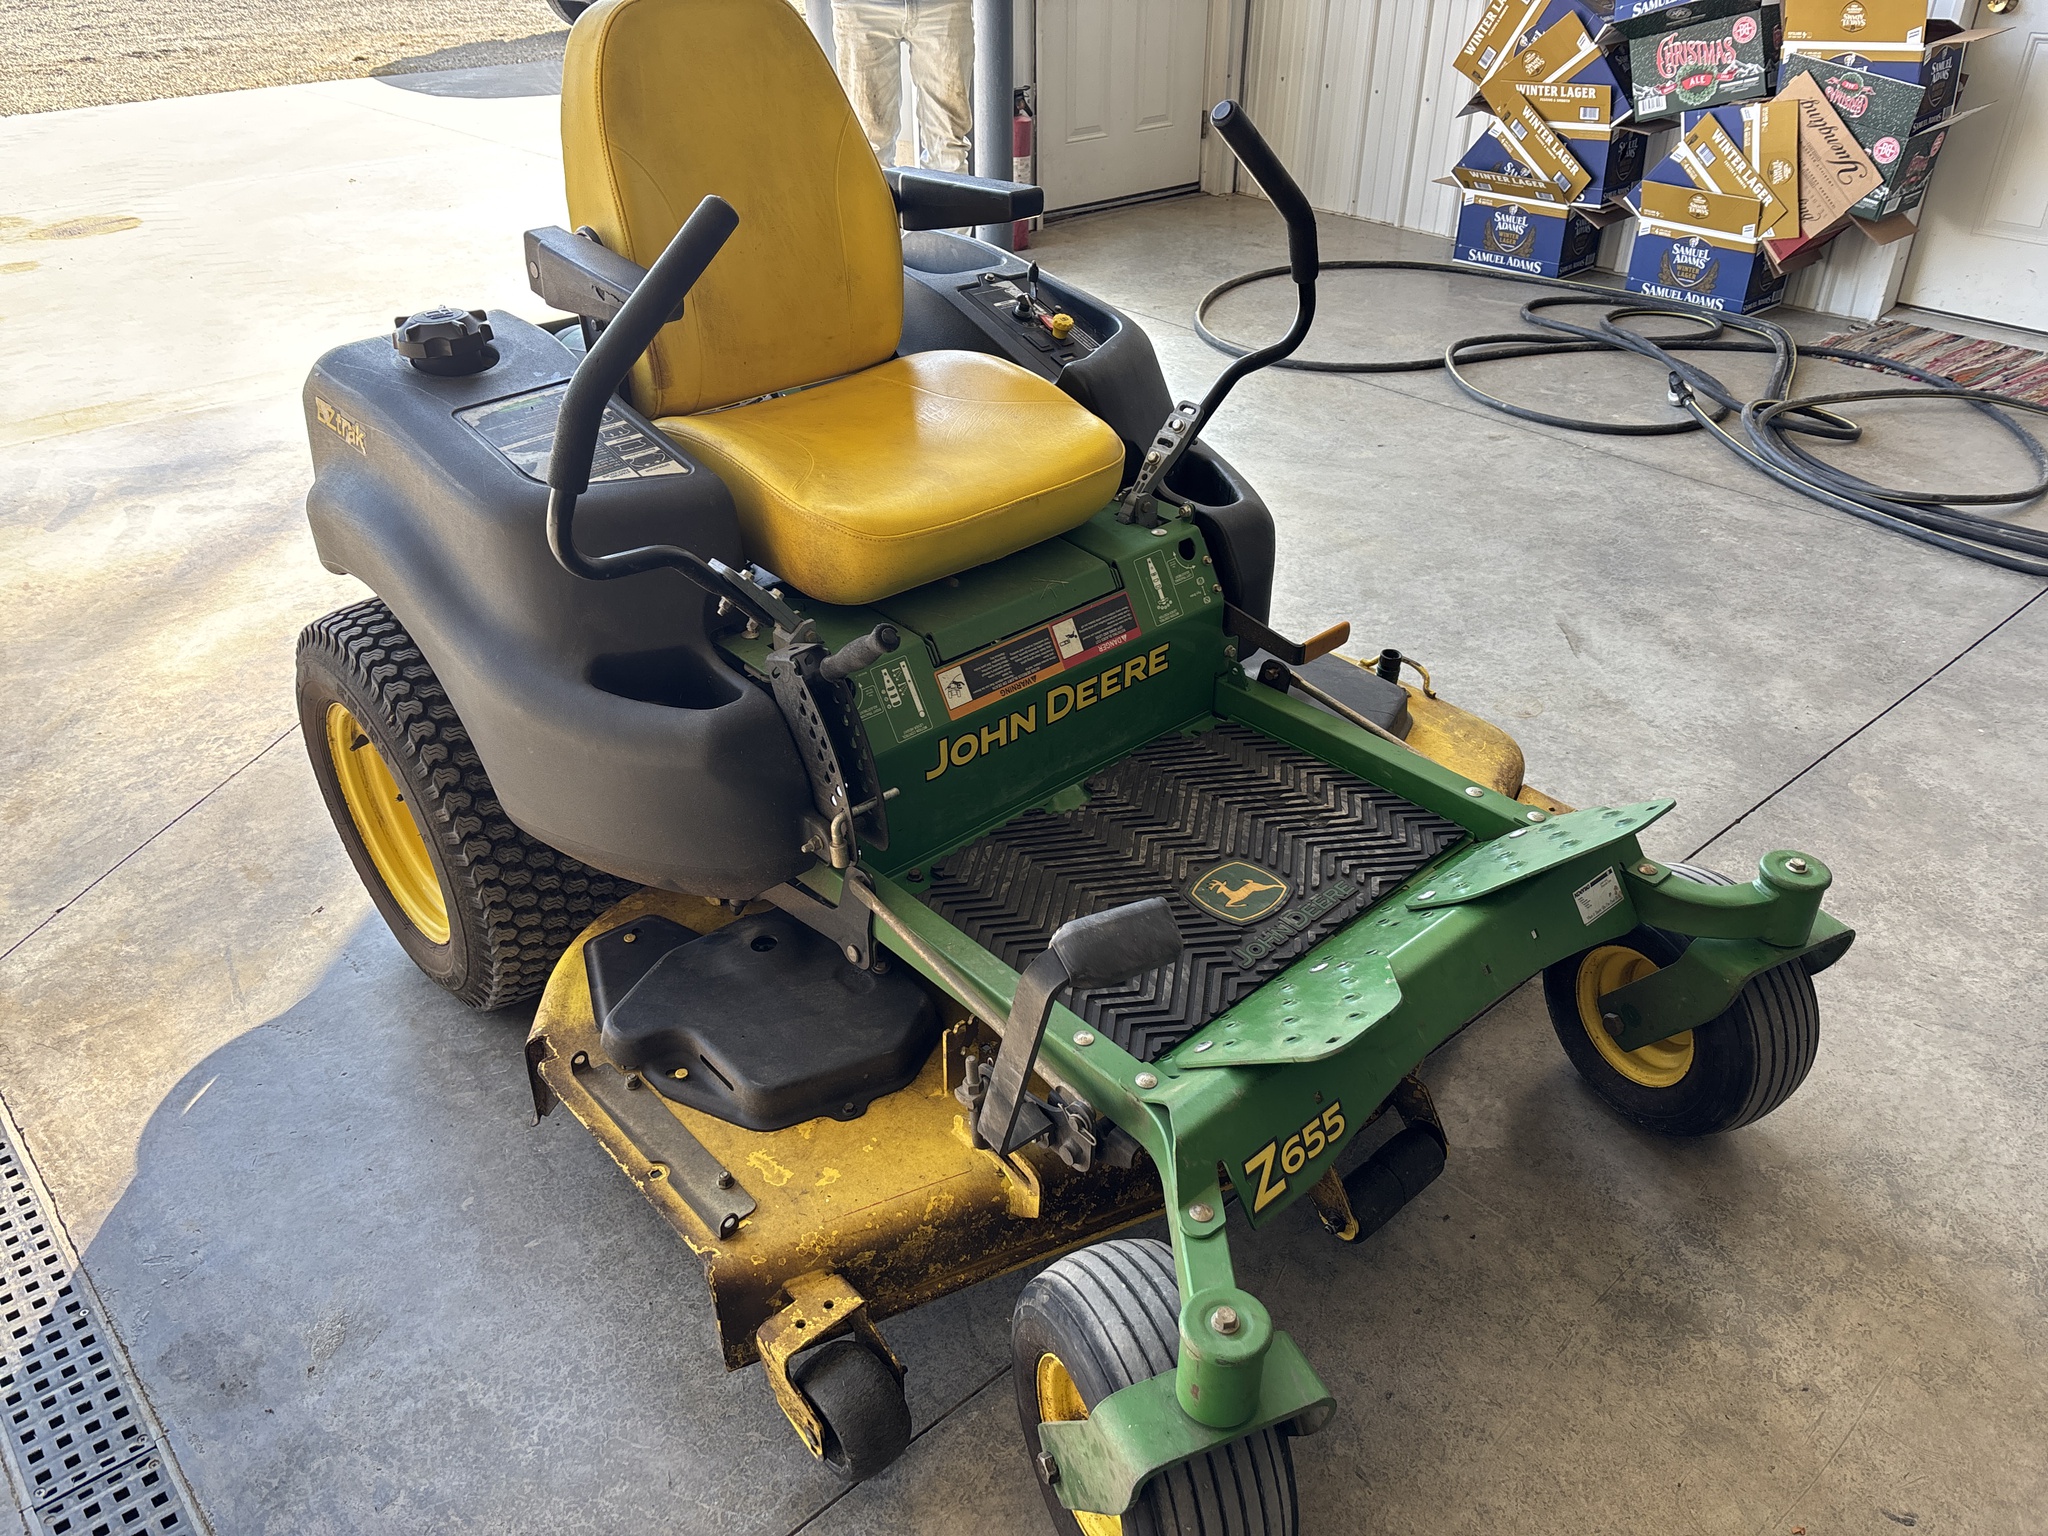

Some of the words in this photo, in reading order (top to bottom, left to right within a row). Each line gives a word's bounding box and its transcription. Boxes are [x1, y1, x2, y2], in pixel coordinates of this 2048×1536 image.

[1463, 11, 1497, 56] WINTER
[1656, 32, 1736, 78] CHRISTMAS
[1688, 75, 1705, 86] ALE
[1515, 84, 1558, 97] WINTER
[1560, 86, 1596, 99] LAGER
[1522, 105, 1555, 146] WINTER
[1552, 145, 1579, 176] LAGER
[1711, 128, 1747, 173] WINTER
[1742, 170, 1774, 207] LAGER
[1469, 170, 1511, 183] WINTER
[1511, 177, 1546, 189] LAGER
[1494, 211, 1528, 227] SAMUEL
[1495, 222, 1524, 235] ADAMS
[1468, 248, 1506, 265] SAMUEL
[1506, 256, 1542, 274] ADAMS
[1672, 243, 1711, 261] SAMUEL
[1673, 254, 1706, 270] ADAMS
[1676, 264, 1700, 274] WINTER
[1677, 271, 1696, 280] LAGER
[1641, 282, 1683, 301] SAMUEL
[1682, 291, 1724, 312] ADAMS
[1098, 636, 1122, 652] DANGER
[1000, 677, 1032, 696] WARNING
[926, 703, 1036, 781] JOHN
[1046, 642, 1170, 724] DEERE
[1284, 880, 1357, 930] DEERE
[1244, 1101, 1345, 1214] Z655
